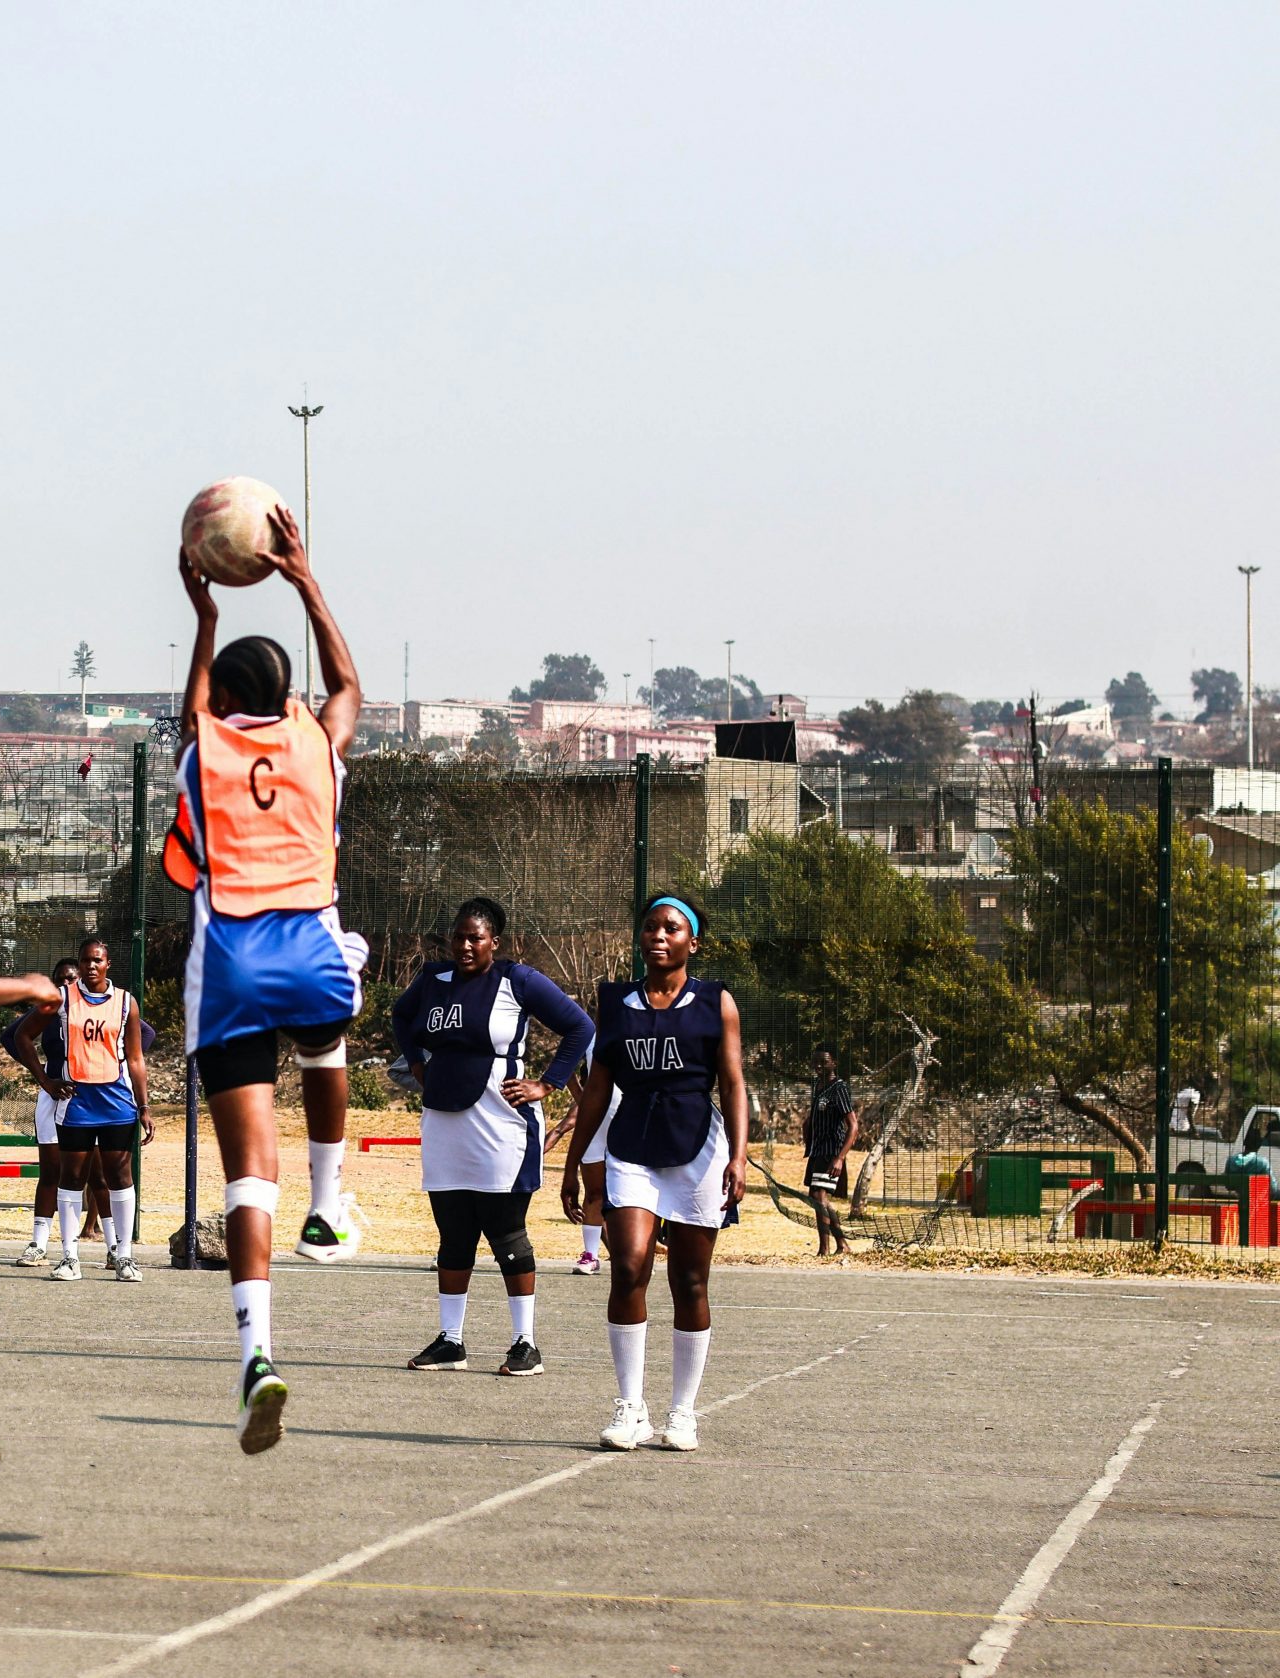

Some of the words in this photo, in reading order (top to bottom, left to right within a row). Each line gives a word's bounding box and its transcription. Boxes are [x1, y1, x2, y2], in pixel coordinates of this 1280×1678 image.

[250, 756, 276, 811] C
[83, 1018, 106, 1042] GK
[426, 1003, 462, 1033] GA
[624, 1036, 684, 1070] WA
